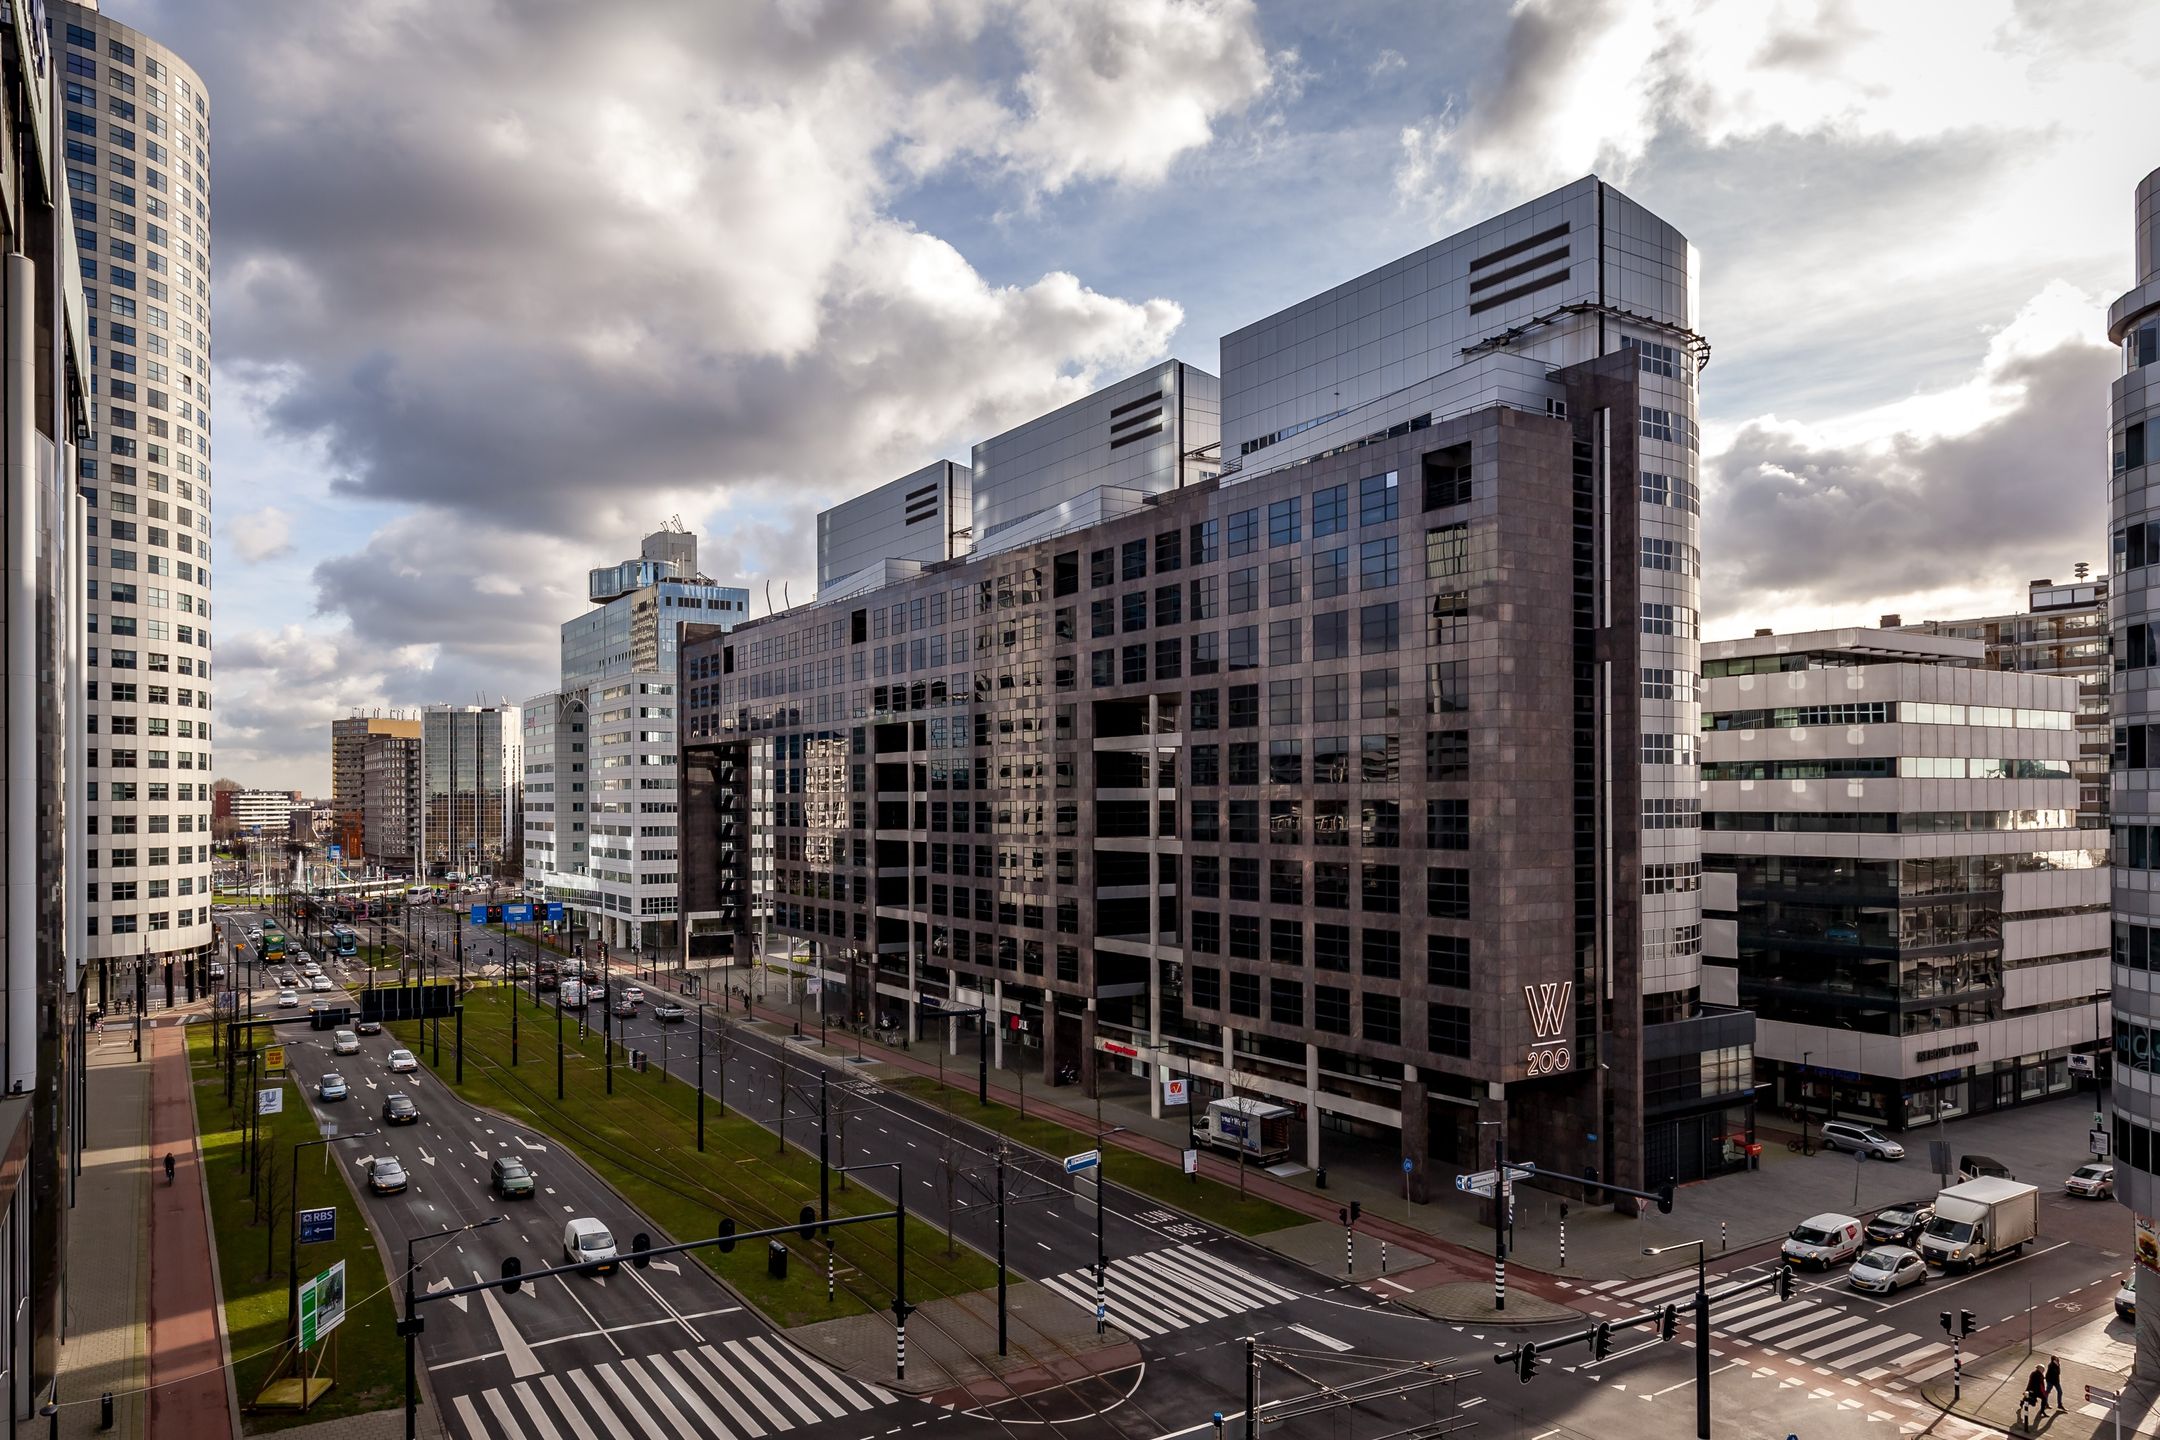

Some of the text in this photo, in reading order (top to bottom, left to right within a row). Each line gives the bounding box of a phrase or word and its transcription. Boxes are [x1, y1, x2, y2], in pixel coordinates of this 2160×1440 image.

[1525, 981, 1572, 1038] W
[1527, 1047, 1571, 1076] 200
[313, 1210, 334, 1222] RBS
[1163, 1223, 1208, 1237] BUS
